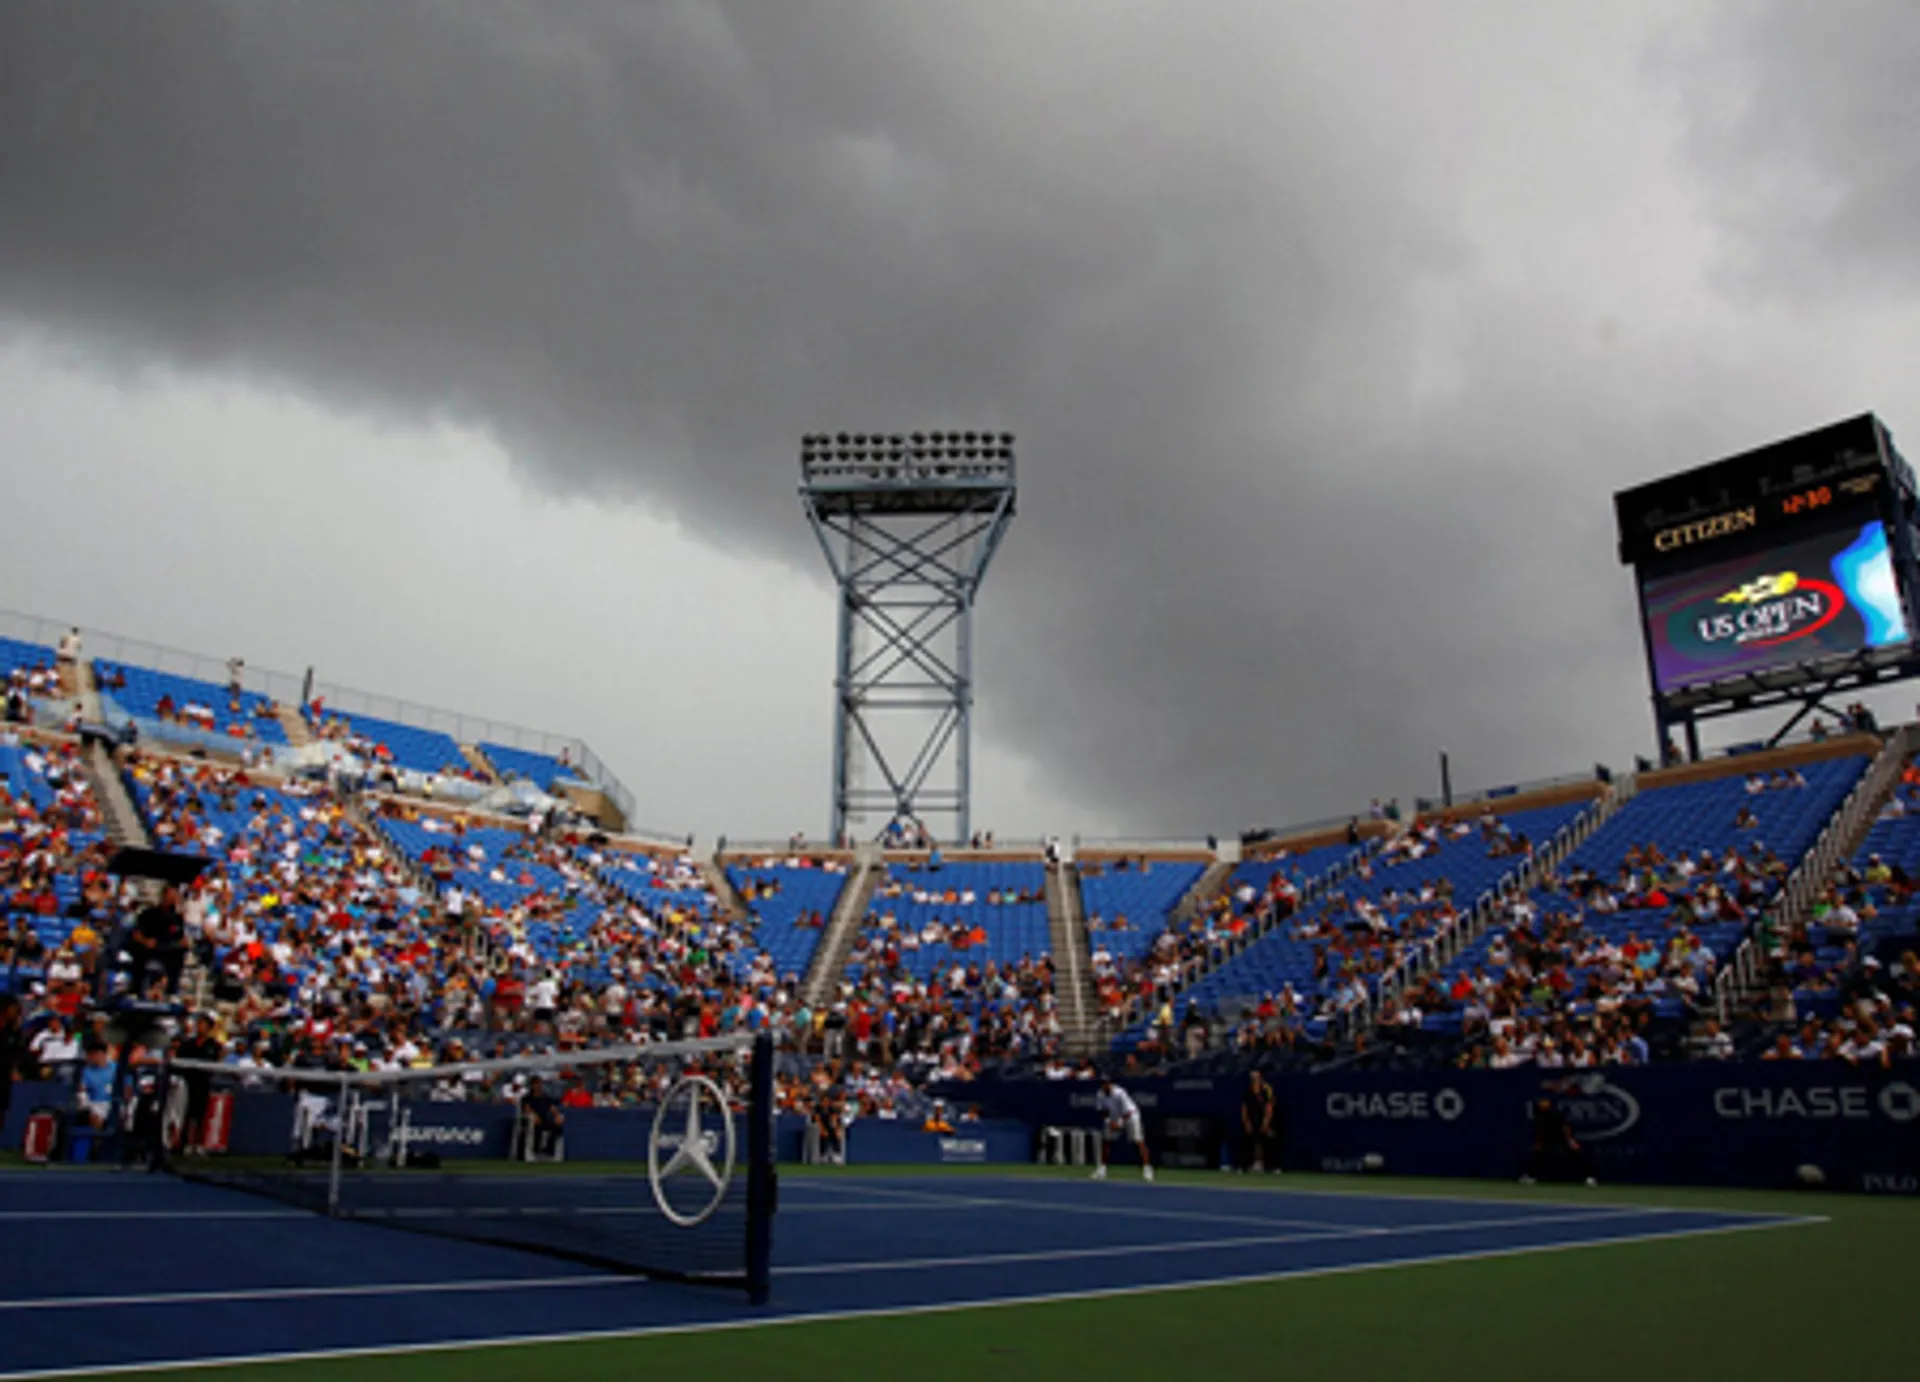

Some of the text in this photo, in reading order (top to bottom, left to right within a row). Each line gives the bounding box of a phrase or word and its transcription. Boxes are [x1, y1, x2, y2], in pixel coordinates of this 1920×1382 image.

[1653, 506, 1757, 552] CITIZEN
[1698, 614, 1735, 642] US
[1736, 592, 1822, 632] OPEN
[1326, 1091, 1430, 1120] CHASE
[1713, 1086, 1871, 1119] CHASE
